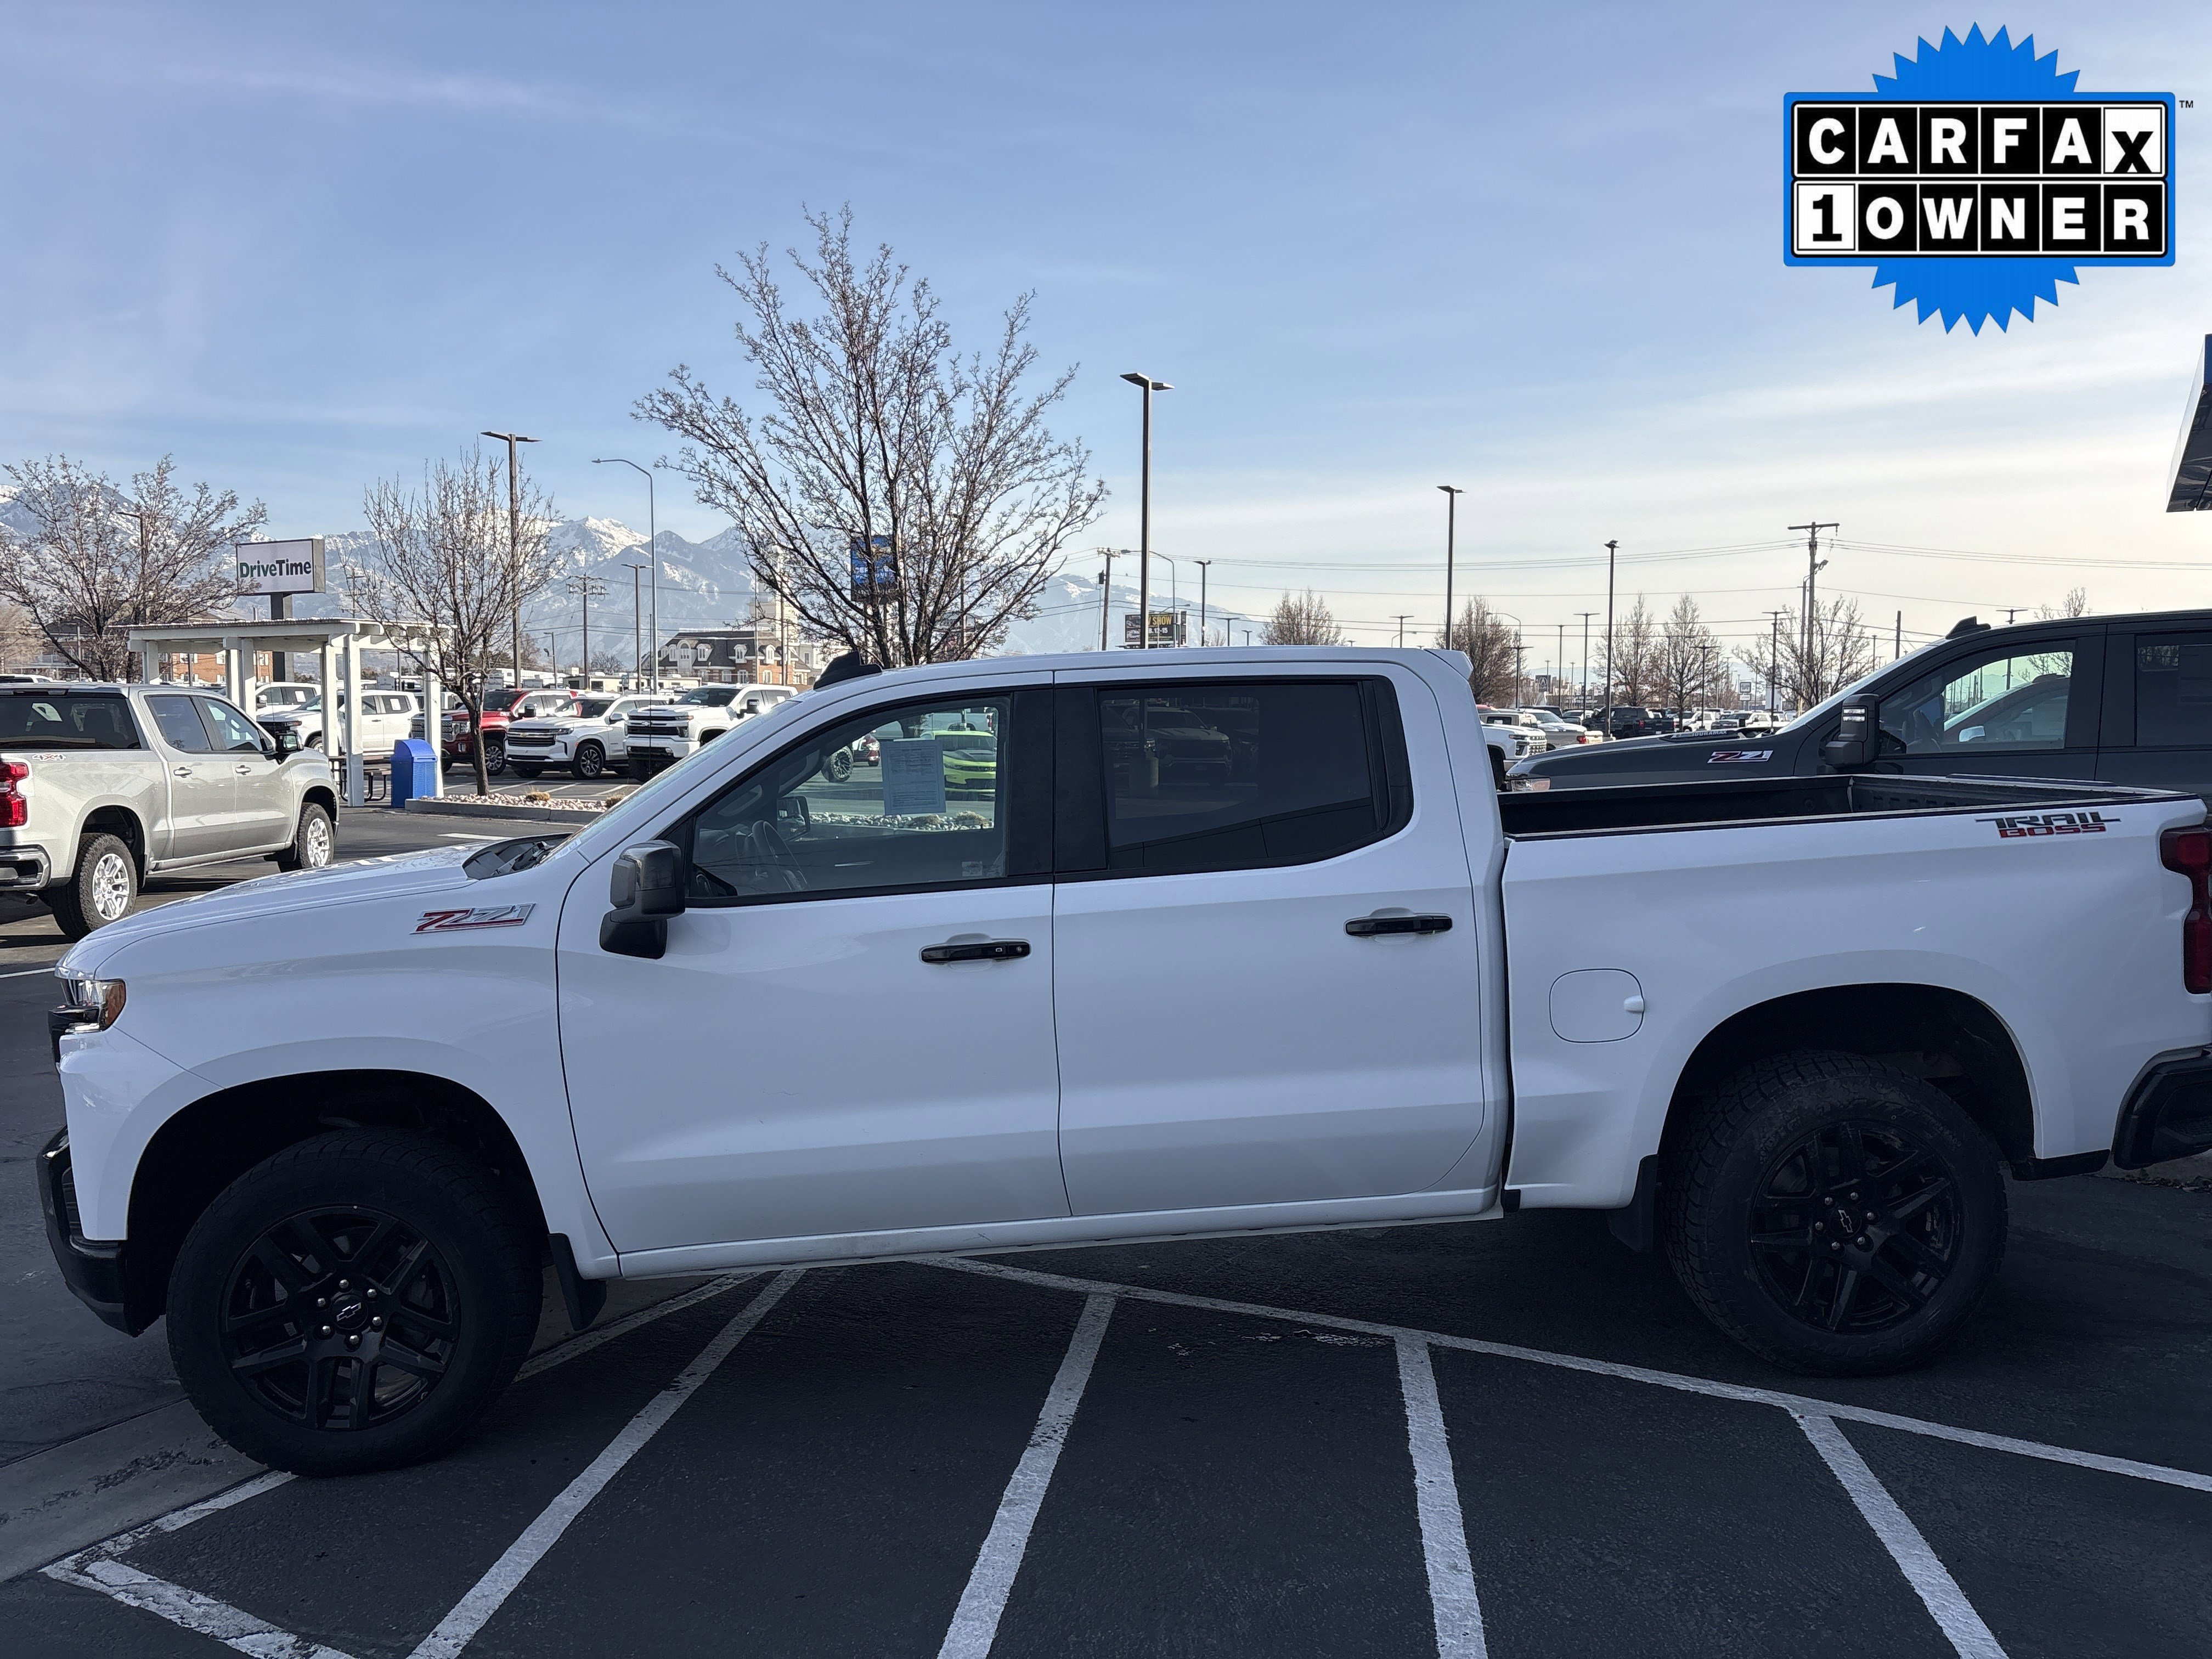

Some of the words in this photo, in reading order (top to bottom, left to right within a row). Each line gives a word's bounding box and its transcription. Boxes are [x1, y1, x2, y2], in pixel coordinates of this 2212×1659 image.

[239, 558, 312, 578] DriveTime
[1152, 616, 1172, 625] SHOW
[1707, 750, 1774, 764] Z71
[1976, 811, 2121, 828] TRAIL
[1999, 823, 2106, 838] BOSS
[410, 904, 537, 935] Z71
